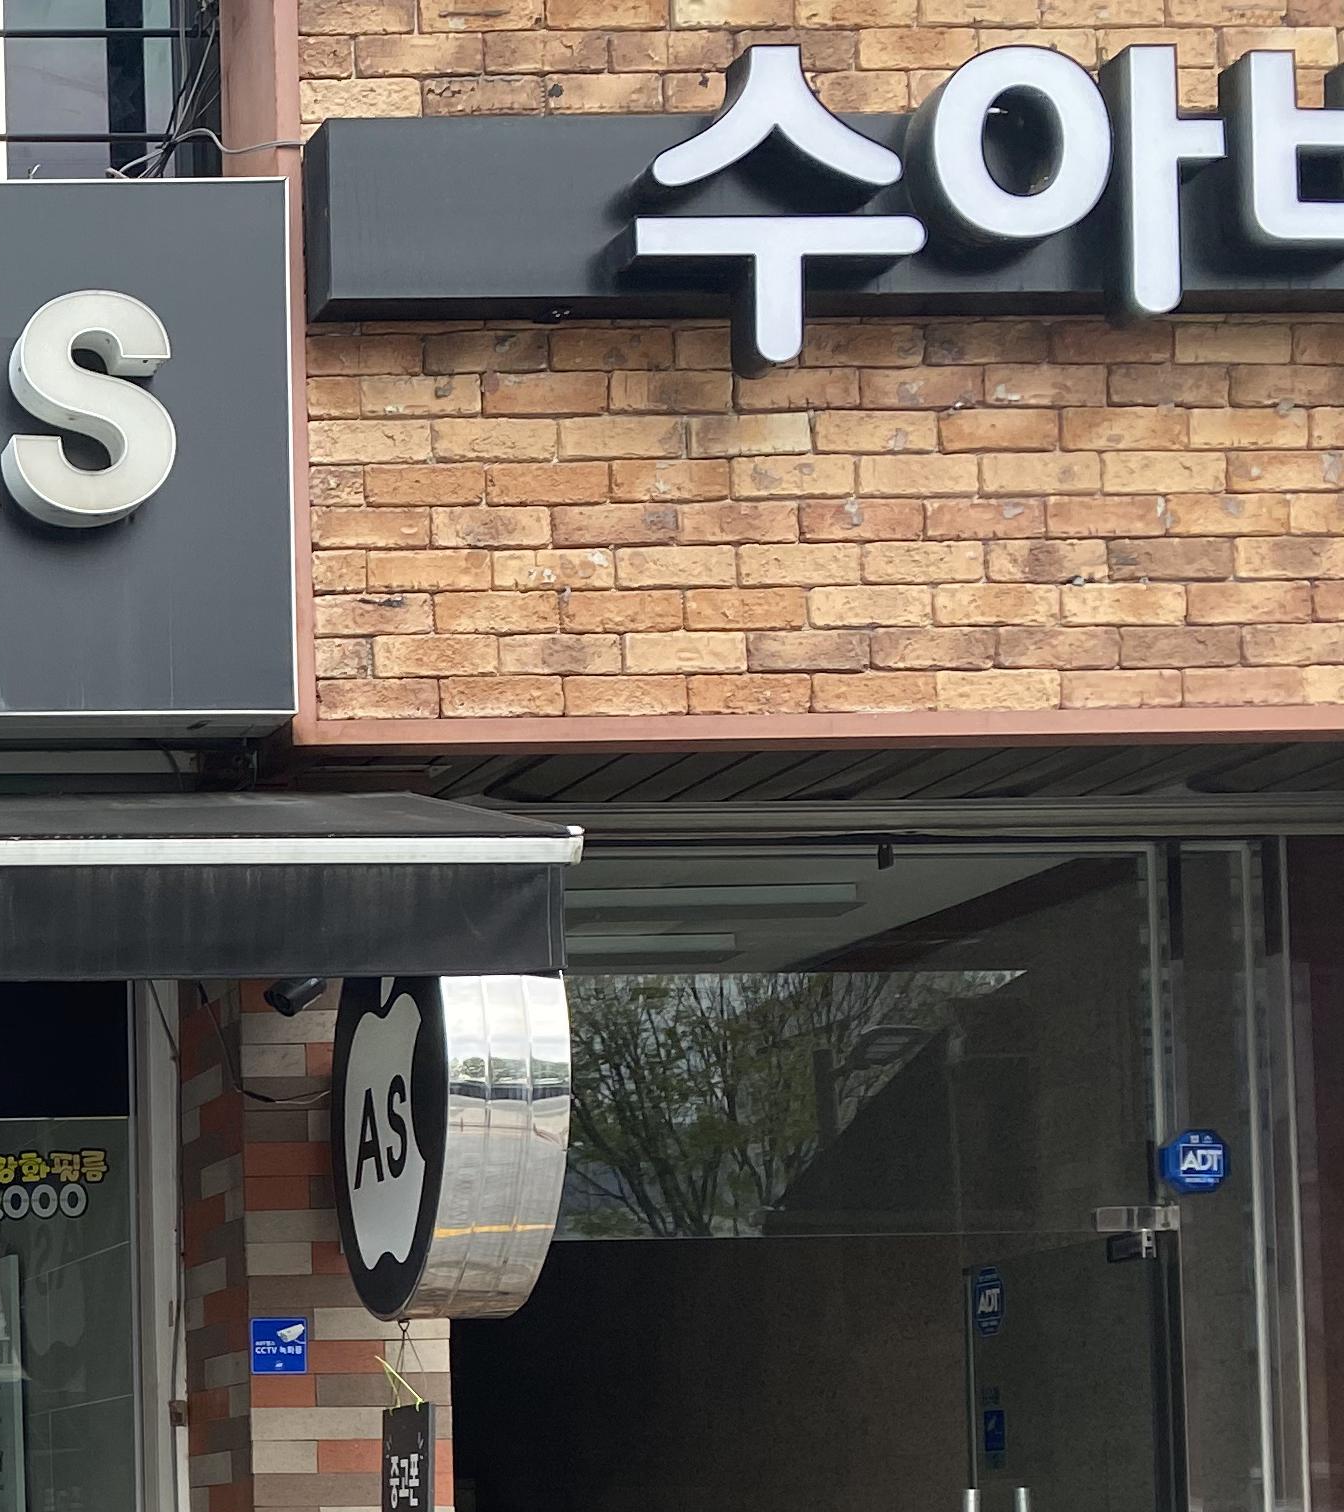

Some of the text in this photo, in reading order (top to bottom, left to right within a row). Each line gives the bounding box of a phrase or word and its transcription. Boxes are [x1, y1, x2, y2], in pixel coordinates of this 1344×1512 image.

[354, 1073, 408, 1190] AS
[1180, 1149, 1223, 1171] ADT
[977, 1288, 1001, 1315] ADT
[255, 1346, 278, 1355] CCTV
[389, 1453, 420, 1510] 중고폰
